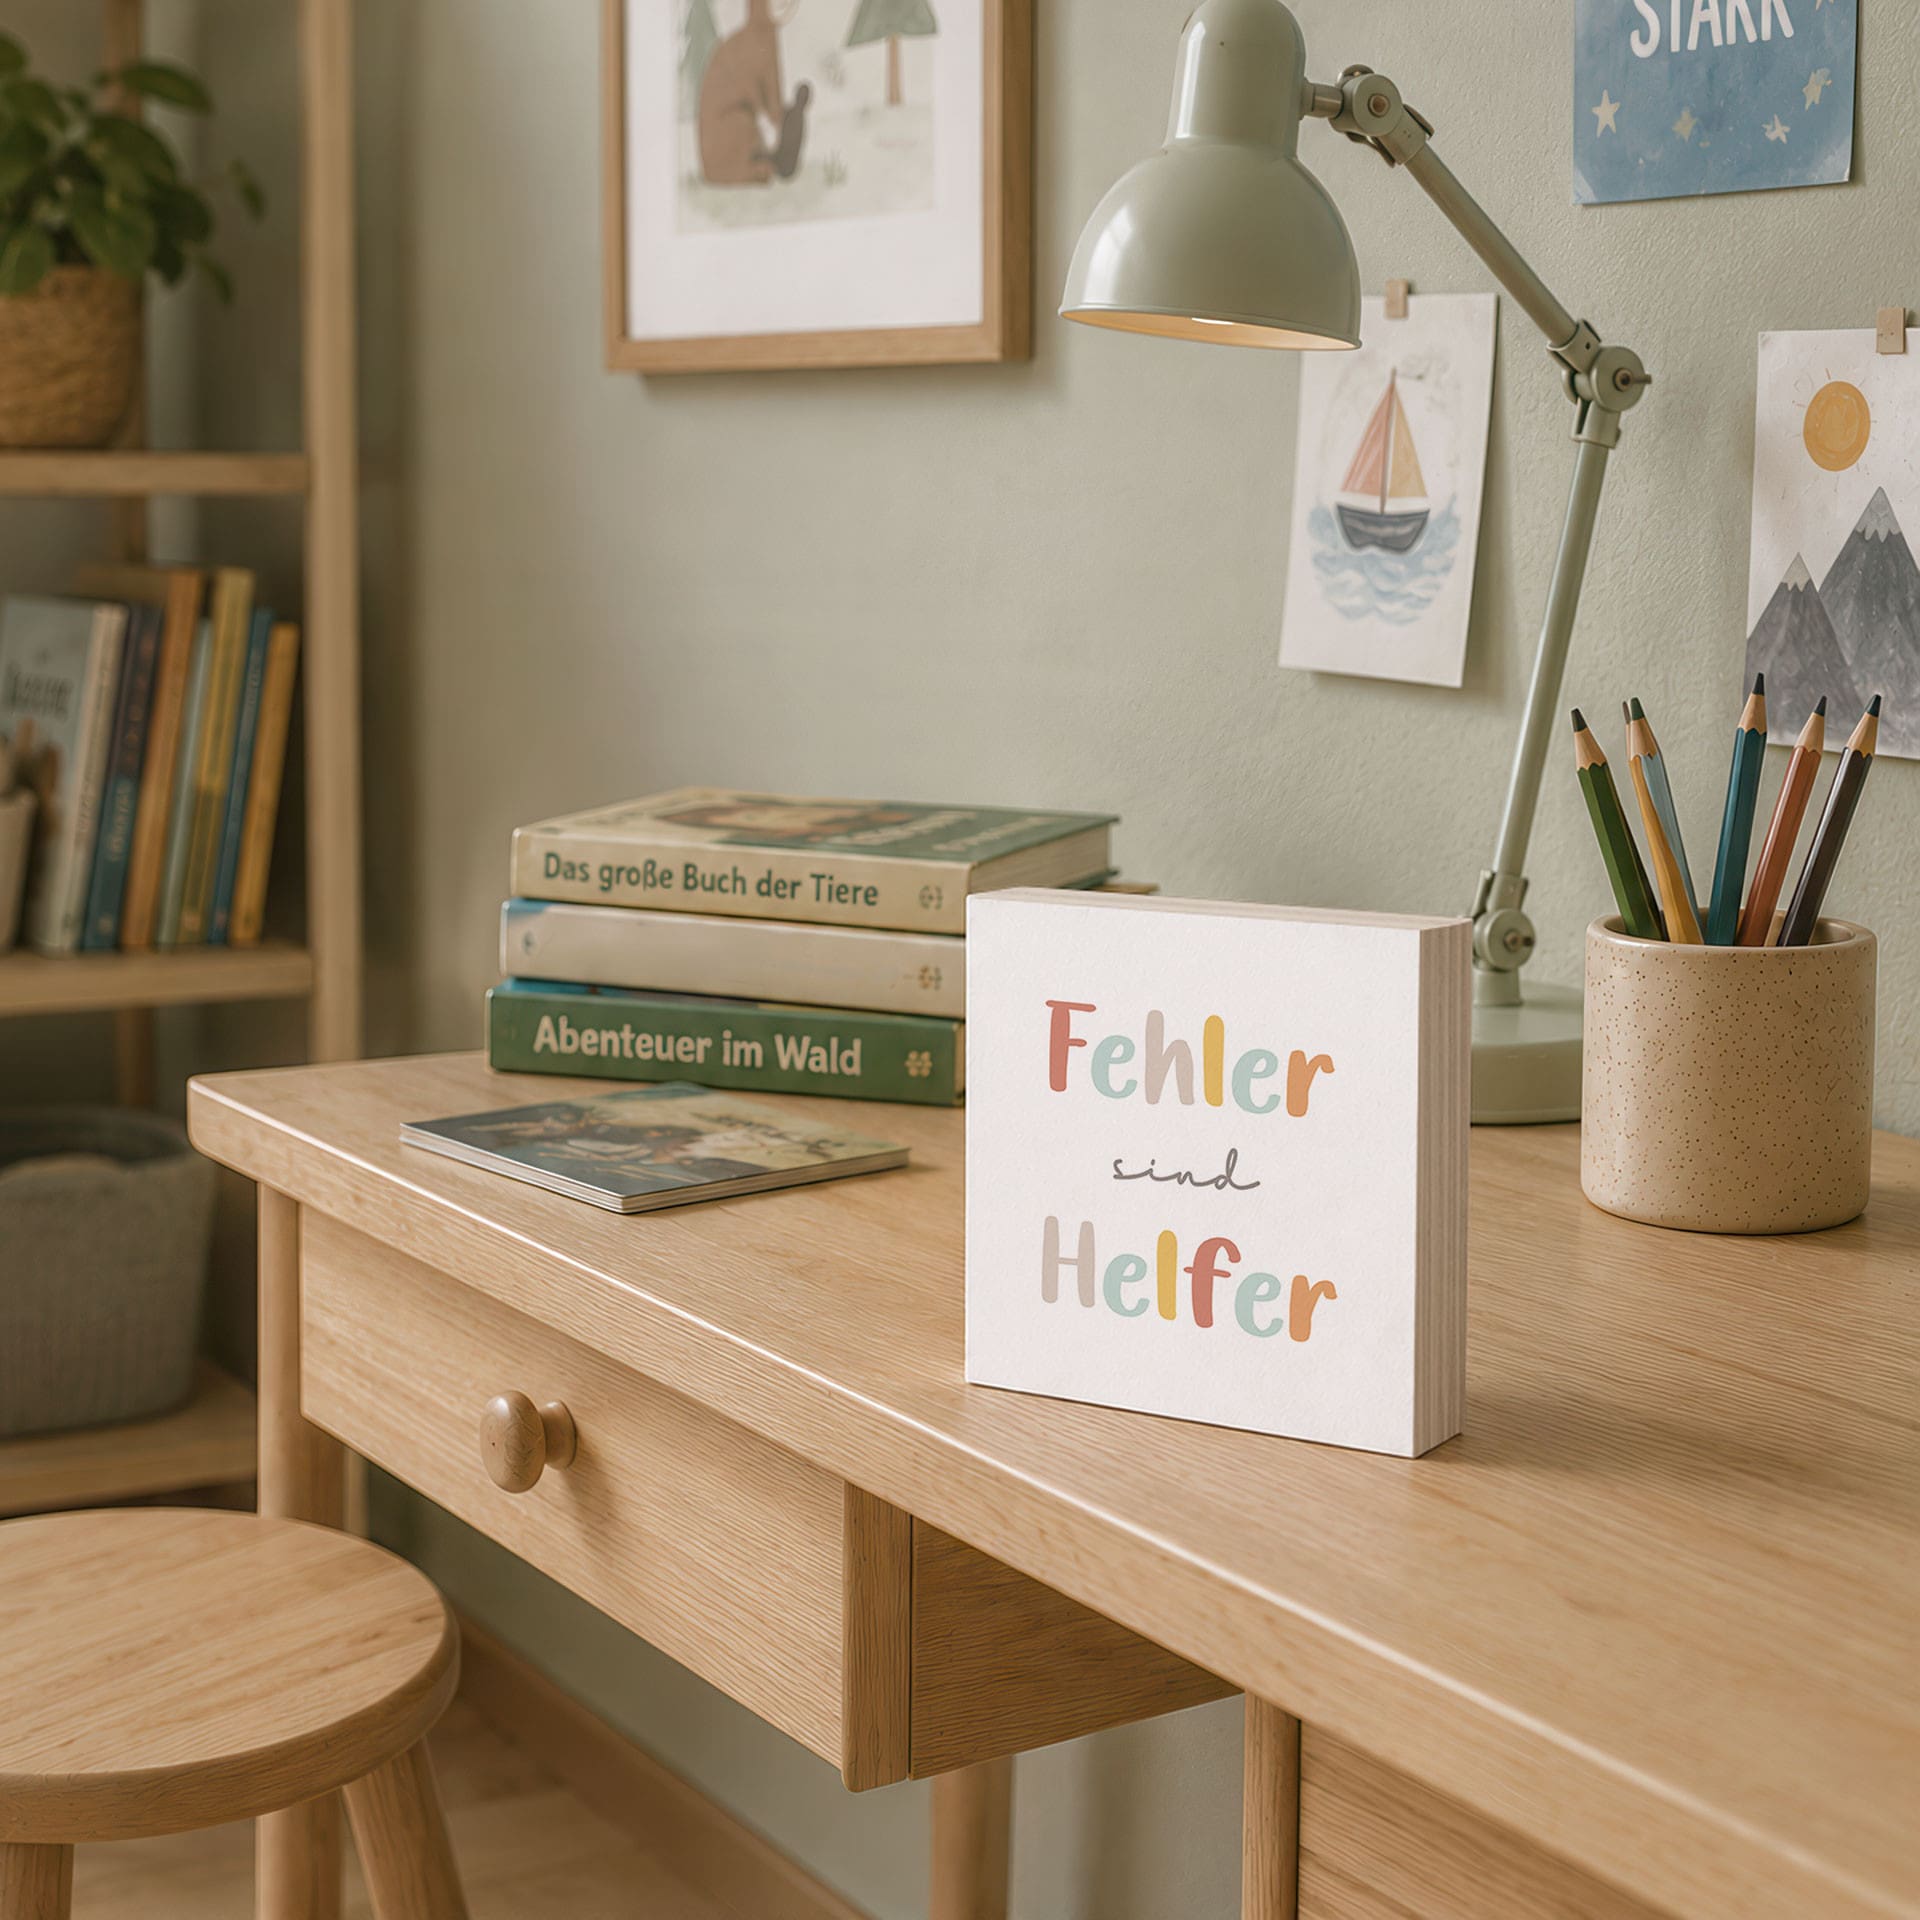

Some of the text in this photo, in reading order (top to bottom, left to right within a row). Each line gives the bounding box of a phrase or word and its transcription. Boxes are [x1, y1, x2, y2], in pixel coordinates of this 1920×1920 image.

[544, 851, 879, 907] Das große Buch der Tiere
[533, 1015, 863, 1077] Abenteuer im Wald
[1045, 999, 1335, 1118] Fehler
[1112, 1147, 1261, 1191] sind
[1041, 1215, 1338, 1343] Helfer
